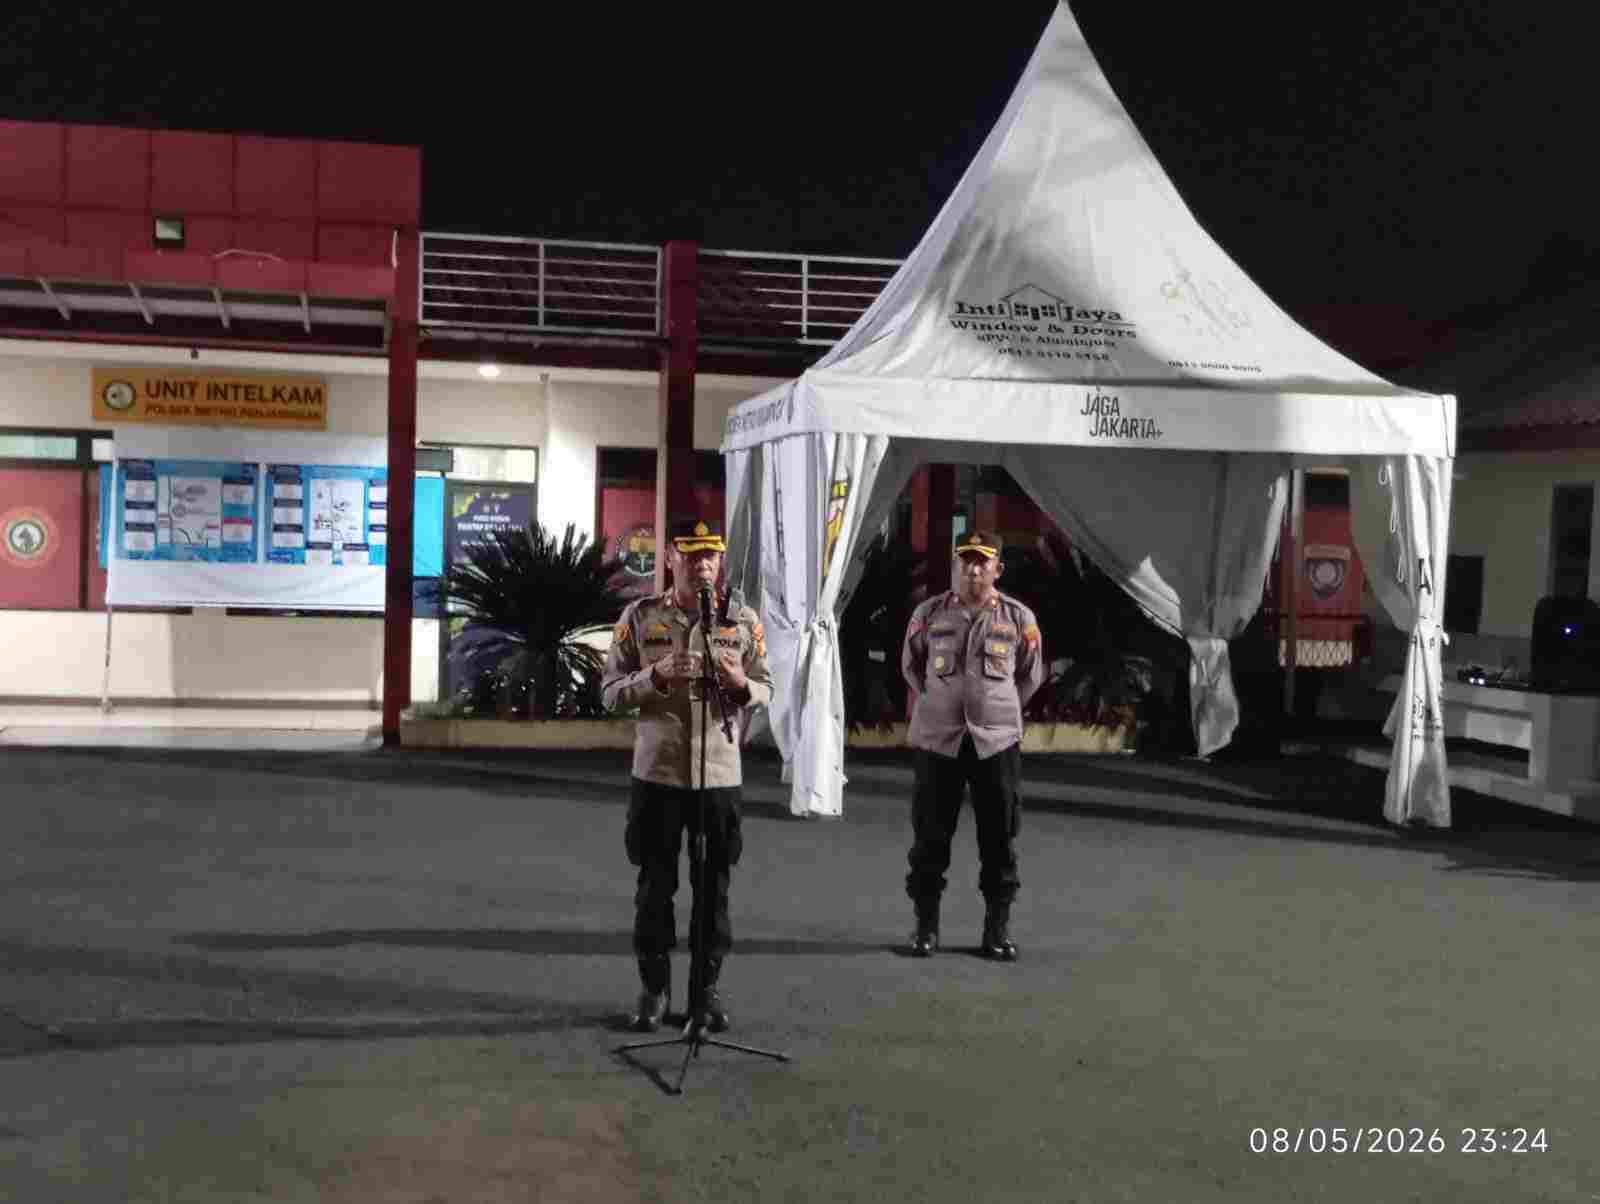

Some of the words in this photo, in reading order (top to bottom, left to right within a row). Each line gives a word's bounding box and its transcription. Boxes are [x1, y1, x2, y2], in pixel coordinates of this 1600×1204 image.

[955, 301, 1006, 316] Inti
[1062, 305, 1123, 322] Jaya
[950, 319, 1038, 333] Window
[1048, 323, 1065, 334] &
[1072, 324, 1137, 339] Doors
[145, 379, 199, 402] UNIT
[206, 381, 323, 405] INTELKAM
[1080, 391, 1120, 416] JAGA
